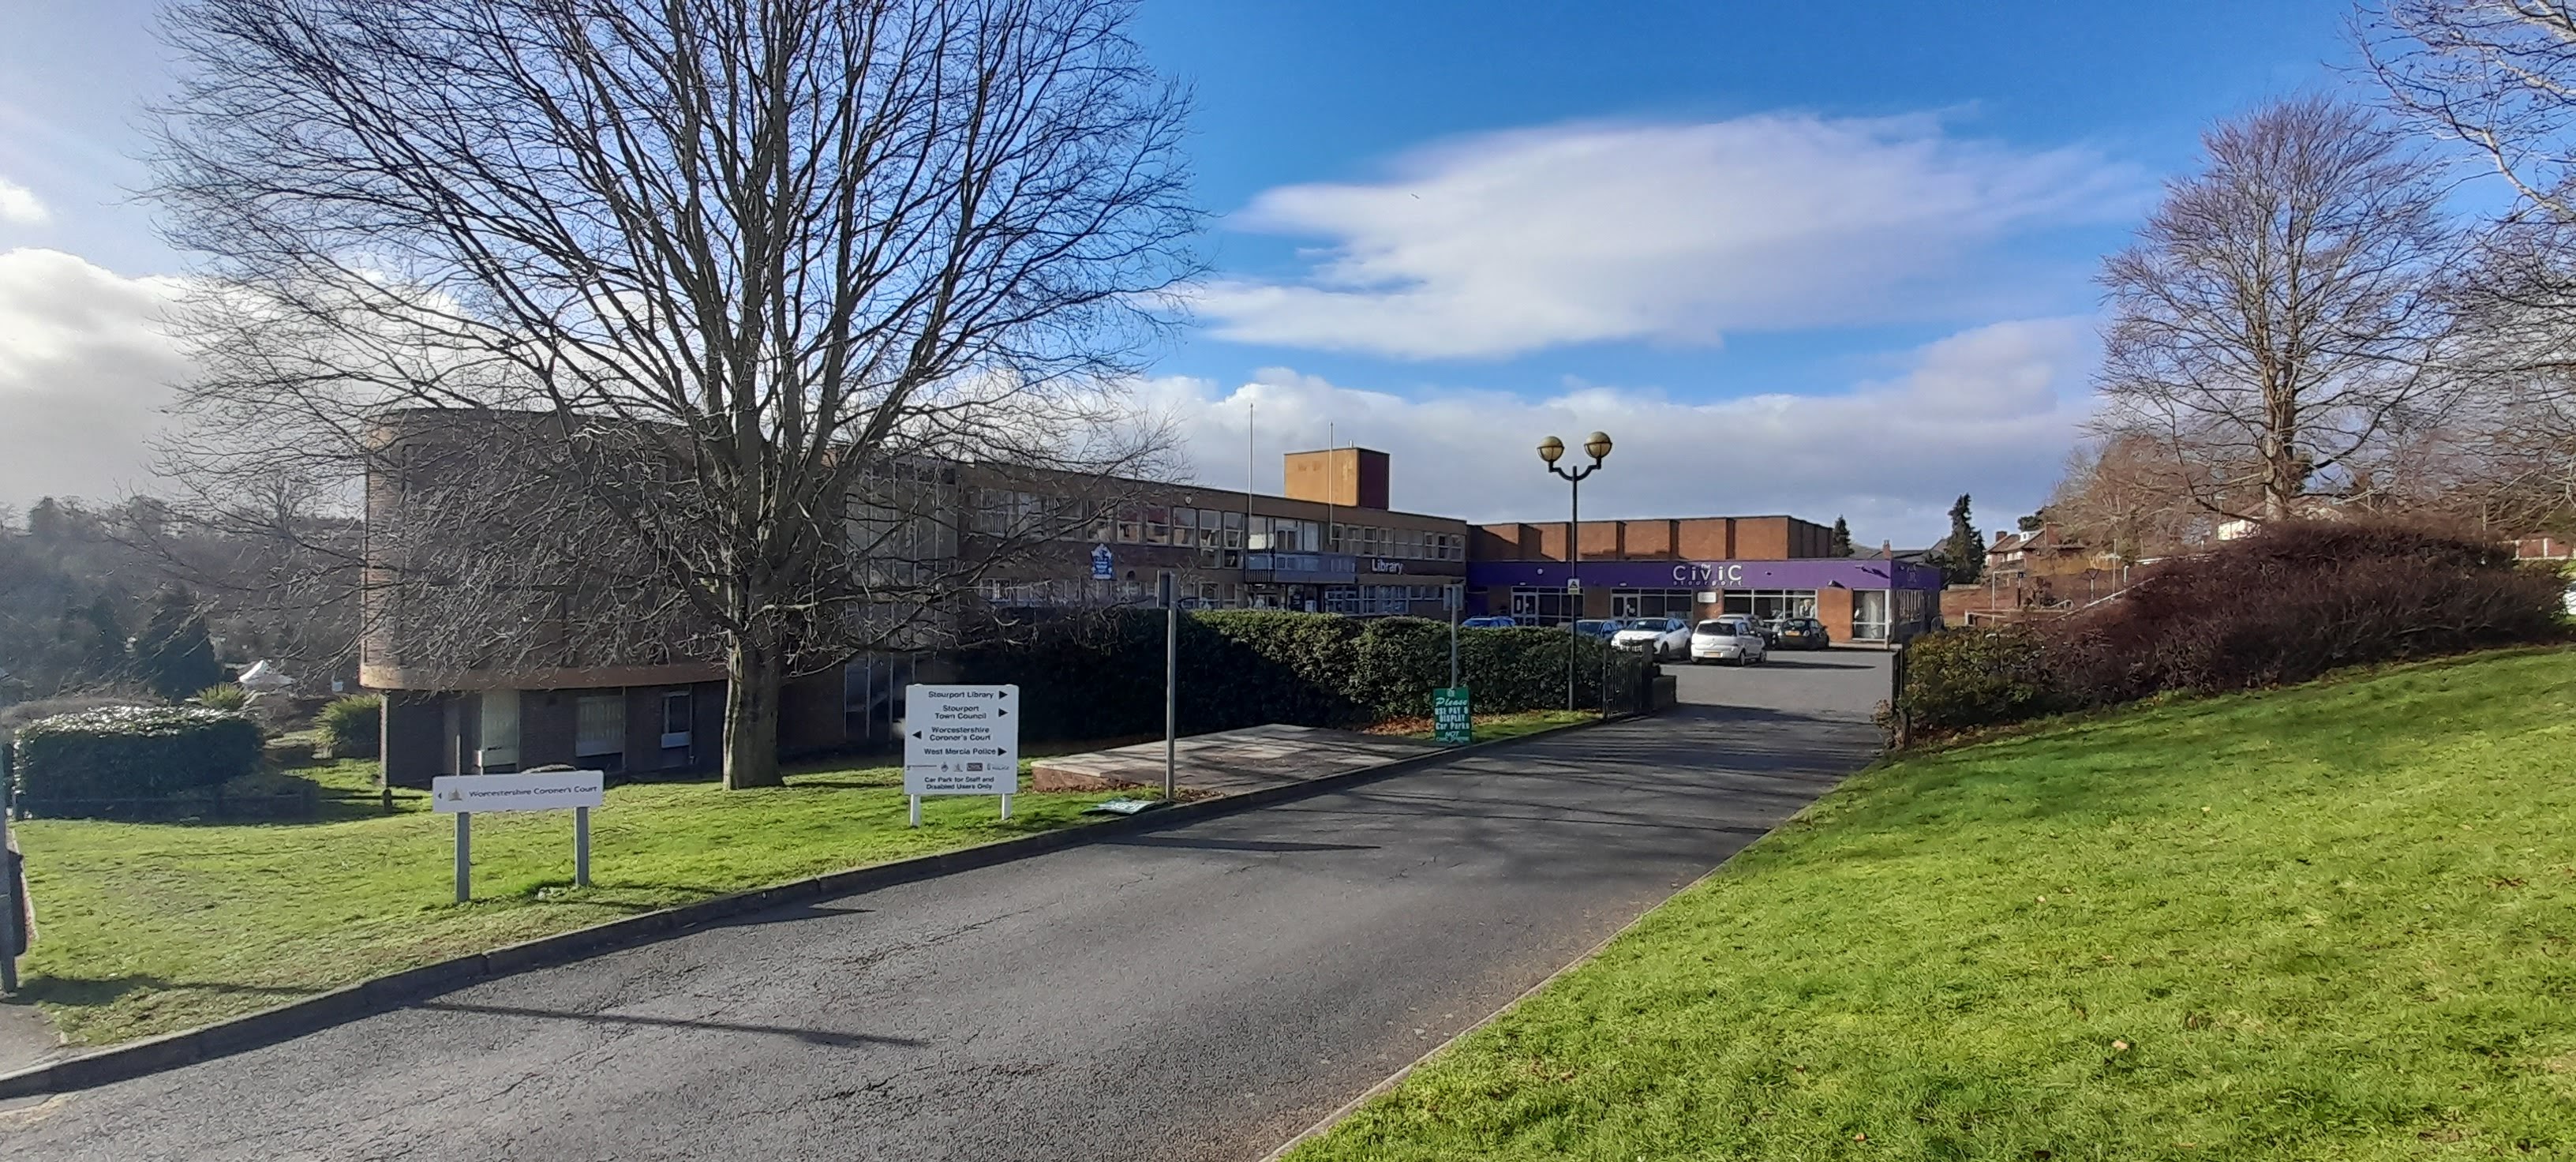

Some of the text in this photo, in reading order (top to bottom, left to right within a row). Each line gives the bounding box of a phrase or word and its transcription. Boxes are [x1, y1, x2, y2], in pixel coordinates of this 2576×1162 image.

[1371, 558, 1403, 575] Library
[967, 691, 994, 699] Library
[1435, 696, 1468, 707] Please
[469, 789, 532, 798] Worcestershire
[534, 787, 571, 796] Coroner's
